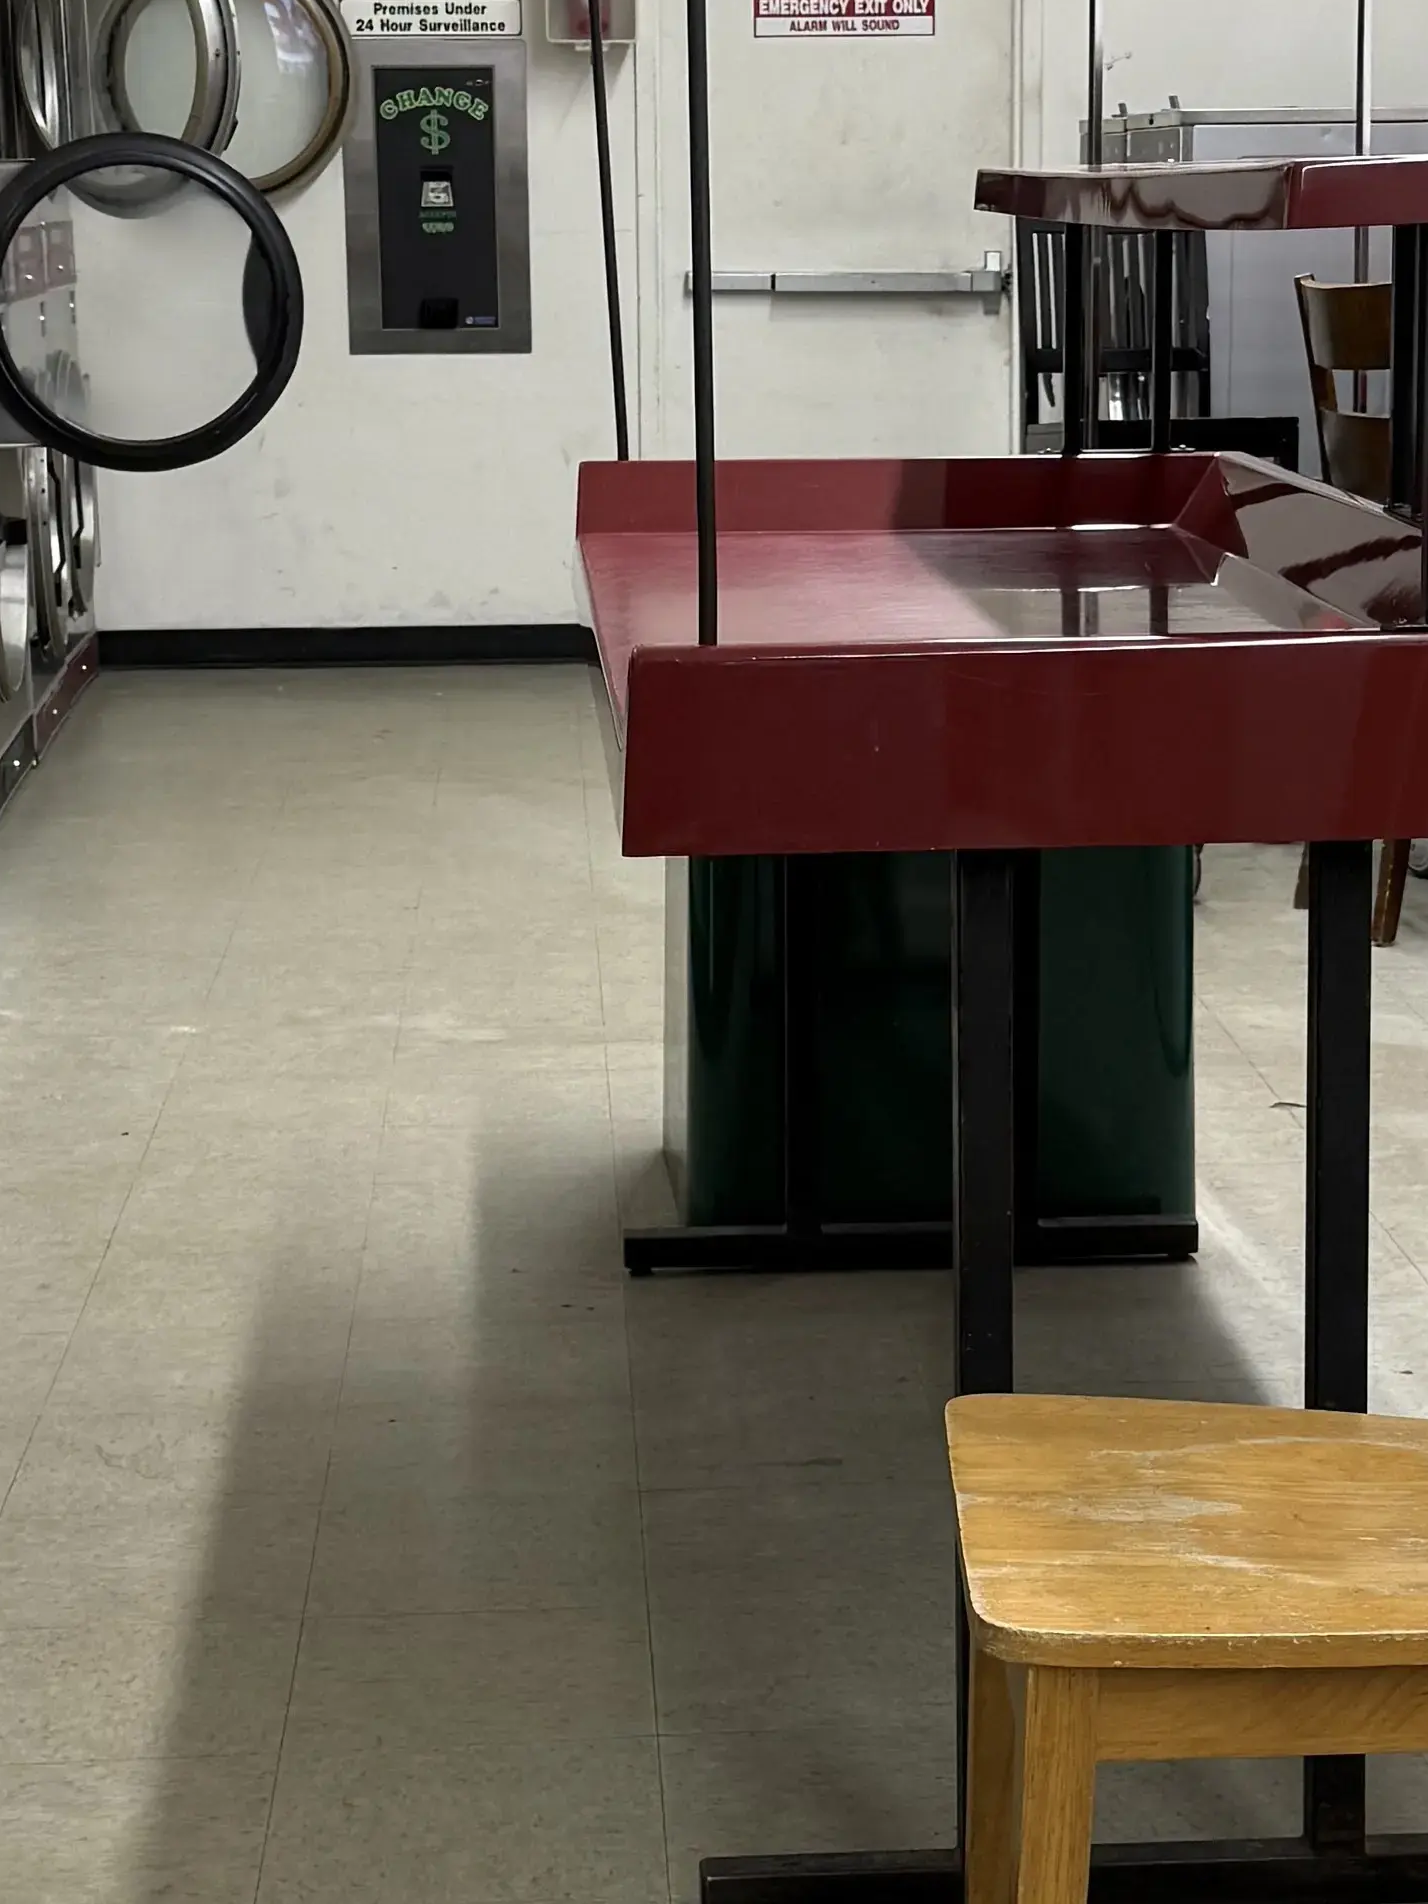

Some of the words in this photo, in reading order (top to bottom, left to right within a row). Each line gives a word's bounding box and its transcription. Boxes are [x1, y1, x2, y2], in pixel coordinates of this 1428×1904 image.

[373, 2, 439, 17] Premises
[445, 2, 487, 17] Under
[356, 19, 373, 32] 24
[380, 19, 413, 32] Hour
[419, 18, 506, 32] Surveillance
[789, 20, 828, 32] ALARM
[832, 20, 857, 31] WILL
[862, 19, 900, 31] SOUND
[379, 86, 489, 121] CHANGE
